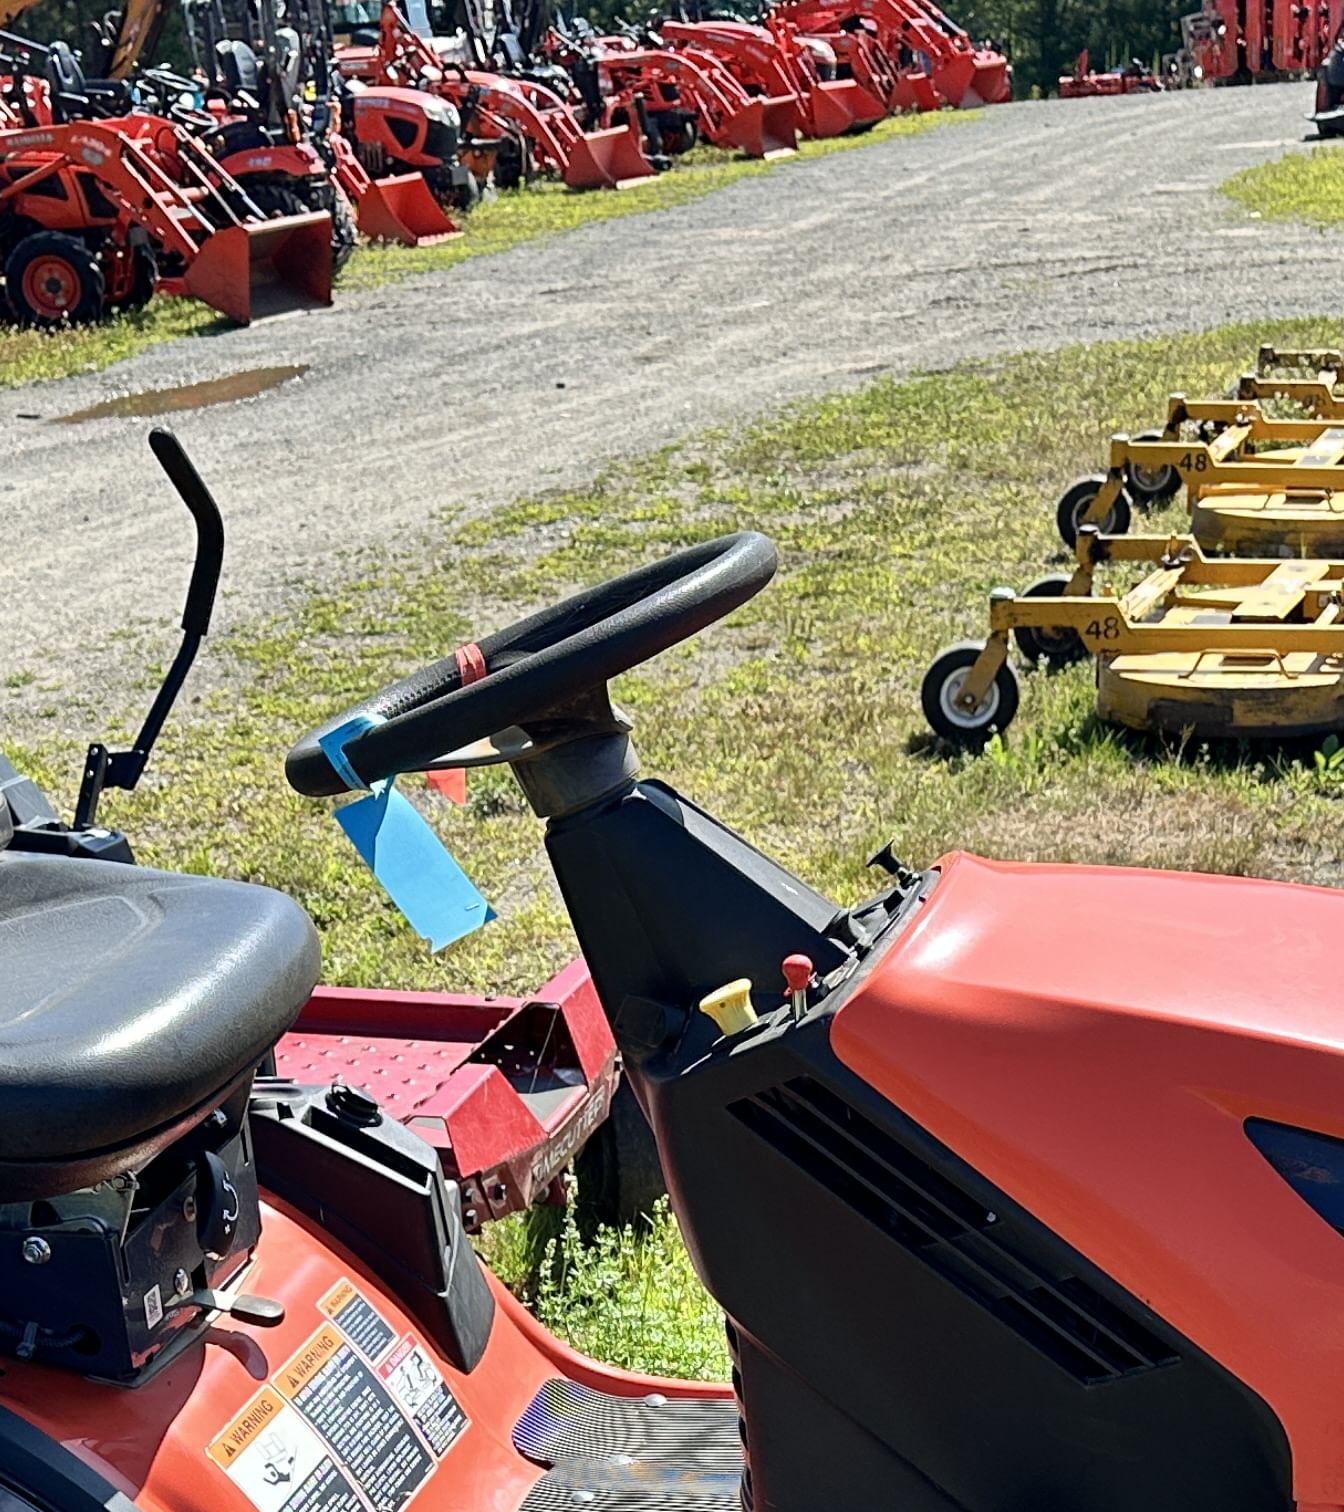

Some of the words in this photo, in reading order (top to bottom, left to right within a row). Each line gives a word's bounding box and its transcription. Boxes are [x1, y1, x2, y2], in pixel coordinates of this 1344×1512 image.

[1179, 452, 1208, 472] 48
[1084, 616, 1121, 641] 48
[294, 1336, 334, 1380] WARNING
[230, 1398, 274, 1445] WARNING
